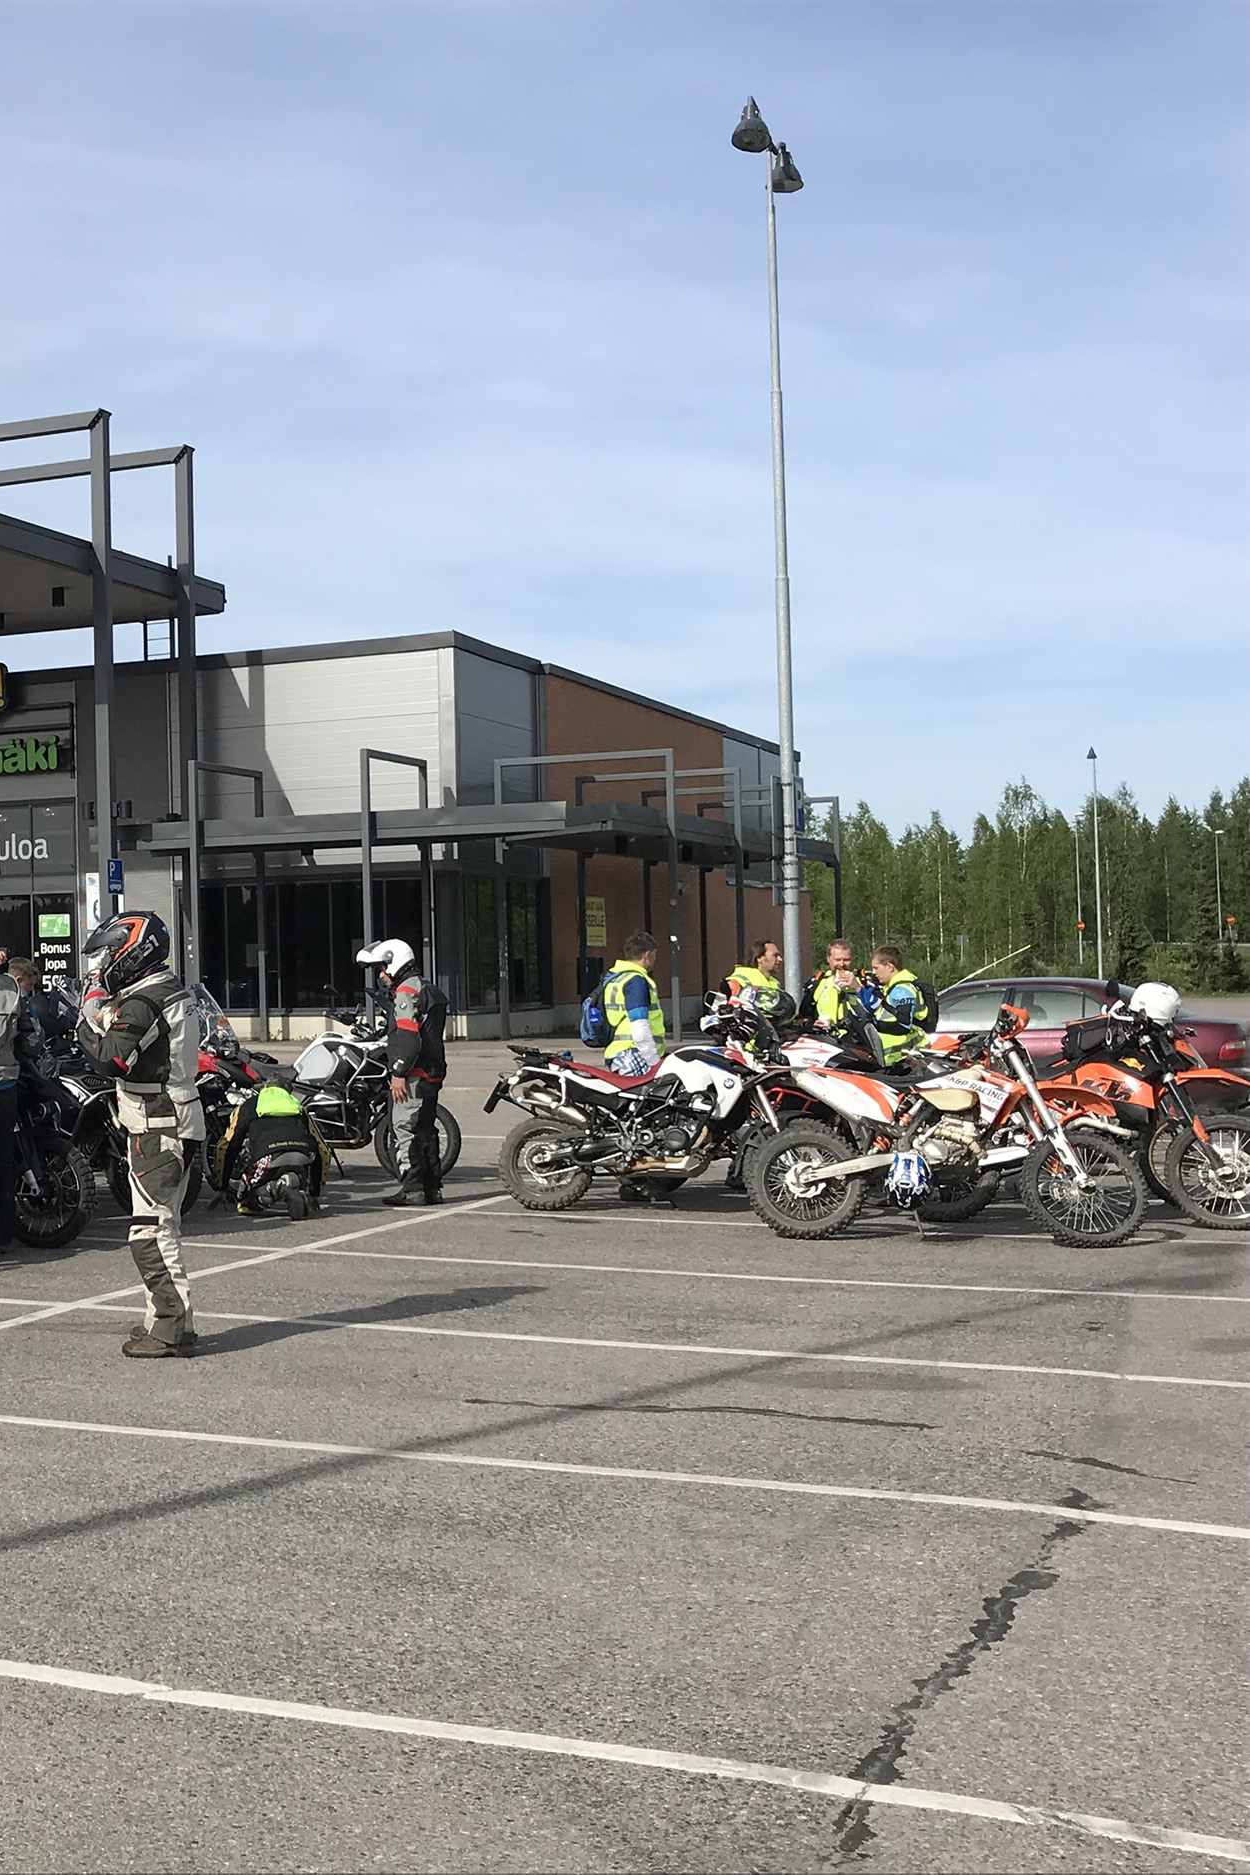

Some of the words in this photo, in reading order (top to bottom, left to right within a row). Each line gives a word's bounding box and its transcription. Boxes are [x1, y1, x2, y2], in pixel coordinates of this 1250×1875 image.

[40, 943, 71, 954] Bonus
[44, 958, 67, 972] jopa
[969, 1083, 1004, 1101] RACING
